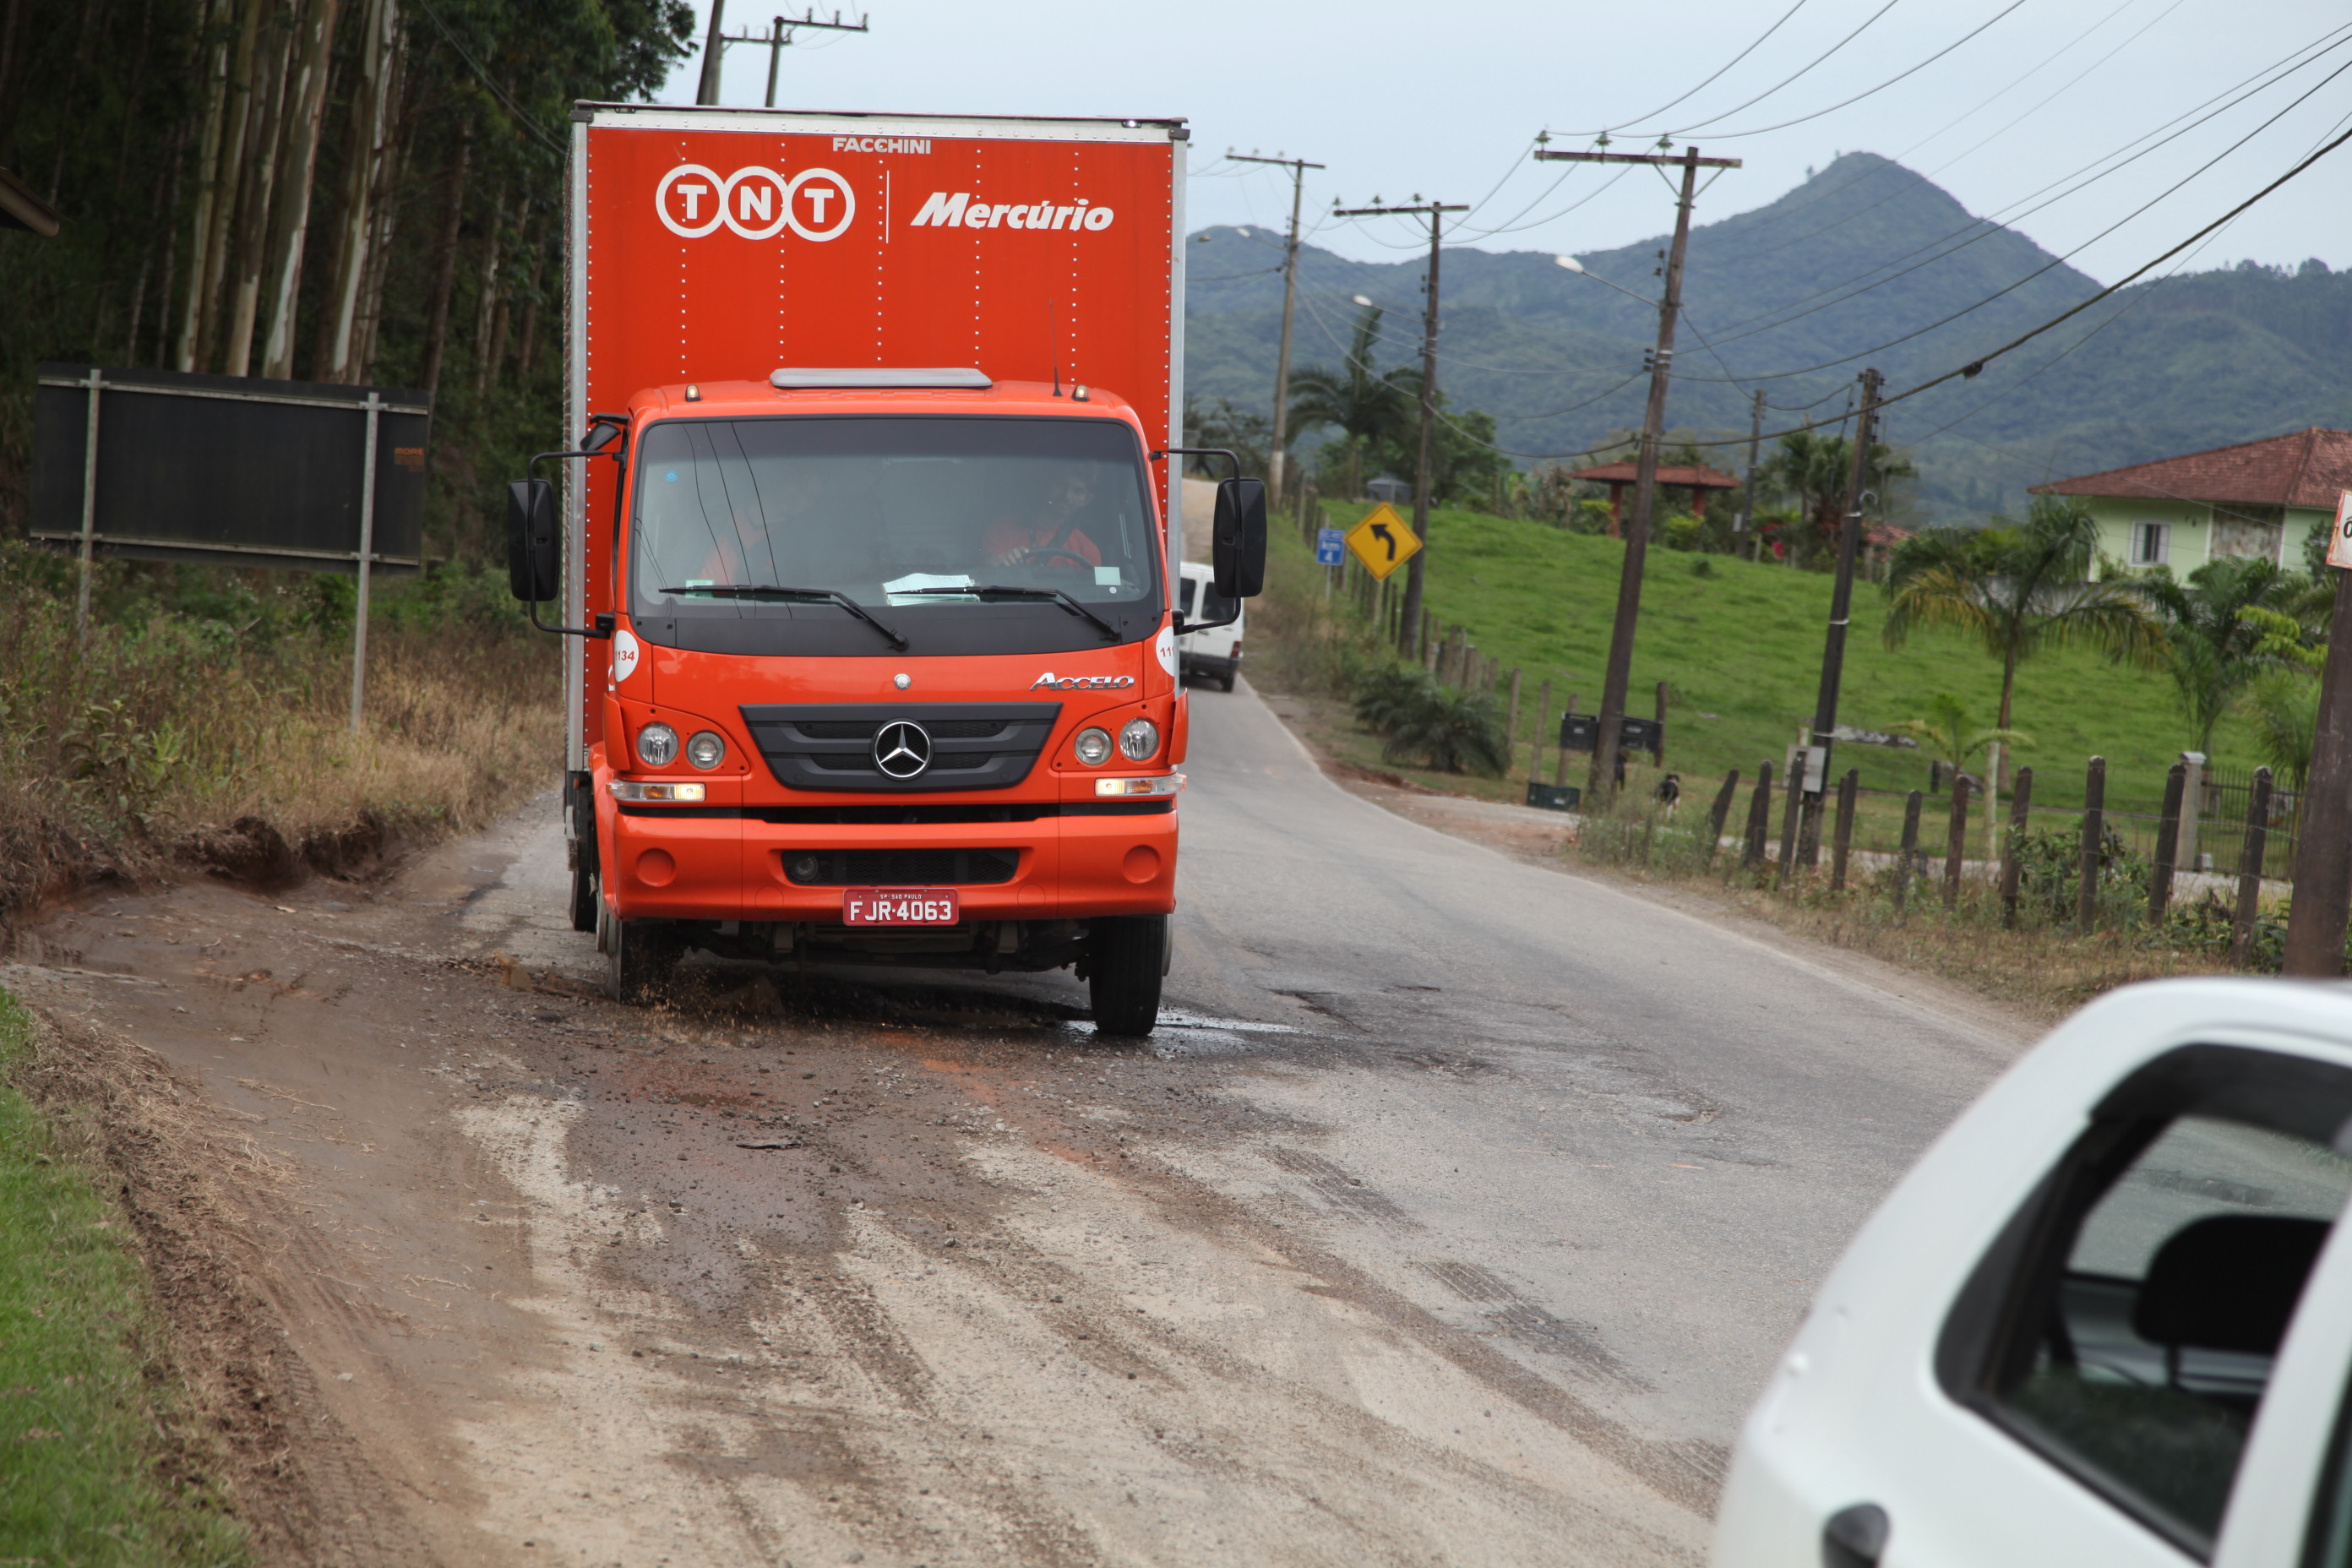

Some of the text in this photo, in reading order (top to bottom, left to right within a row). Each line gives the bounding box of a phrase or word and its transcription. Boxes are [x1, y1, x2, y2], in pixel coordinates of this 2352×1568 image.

[832, 137, 931, 154] FACCHINI
[677, 184, 835, 223] TNT
[910, 192, 1114, 231] Mercúrio
